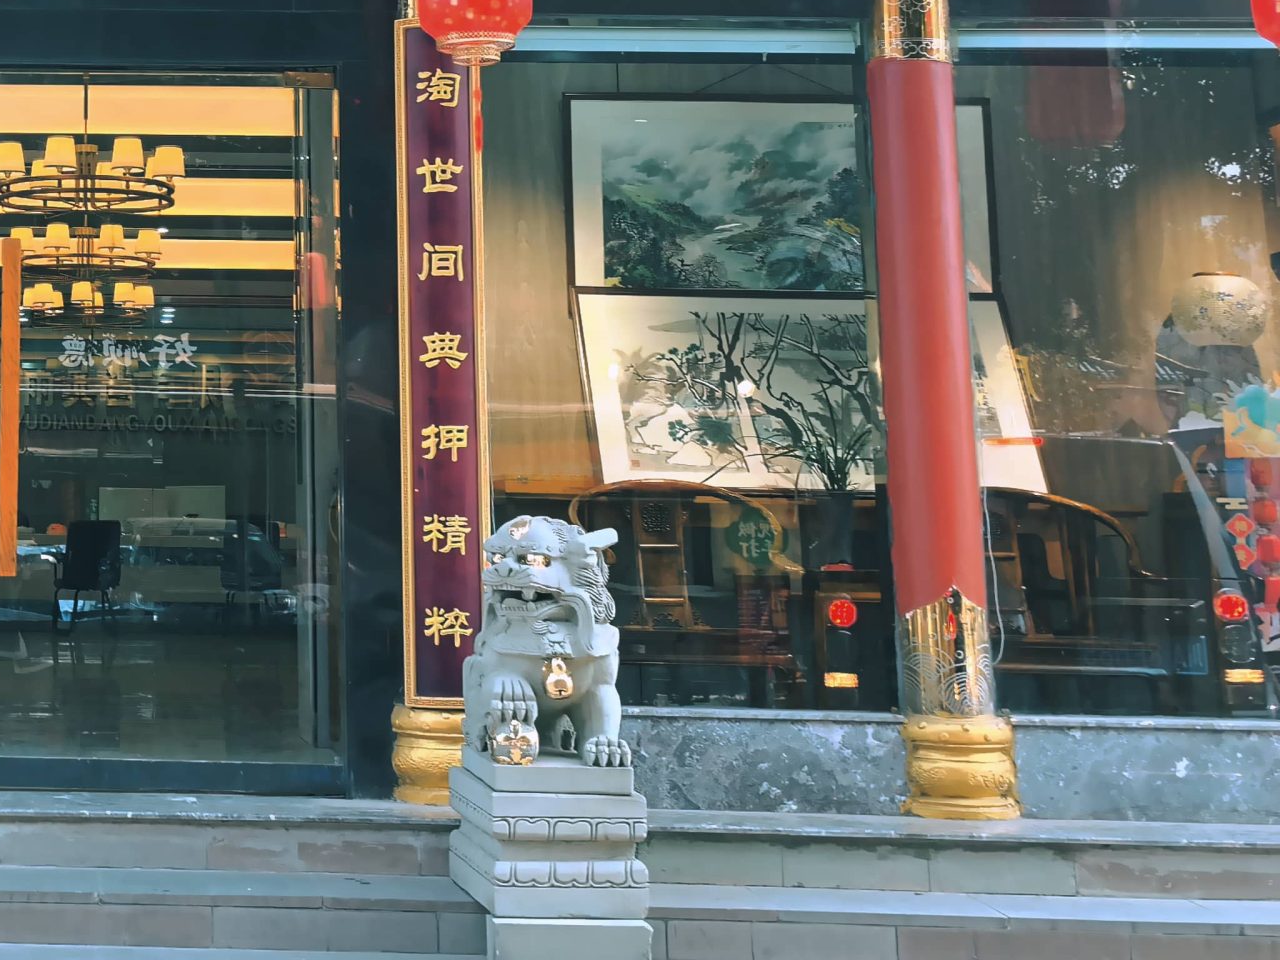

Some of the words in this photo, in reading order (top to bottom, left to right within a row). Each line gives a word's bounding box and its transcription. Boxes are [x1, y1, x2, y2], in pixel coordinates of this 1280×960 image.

[415, 67, 475, 649] 淘世间典押精粹
